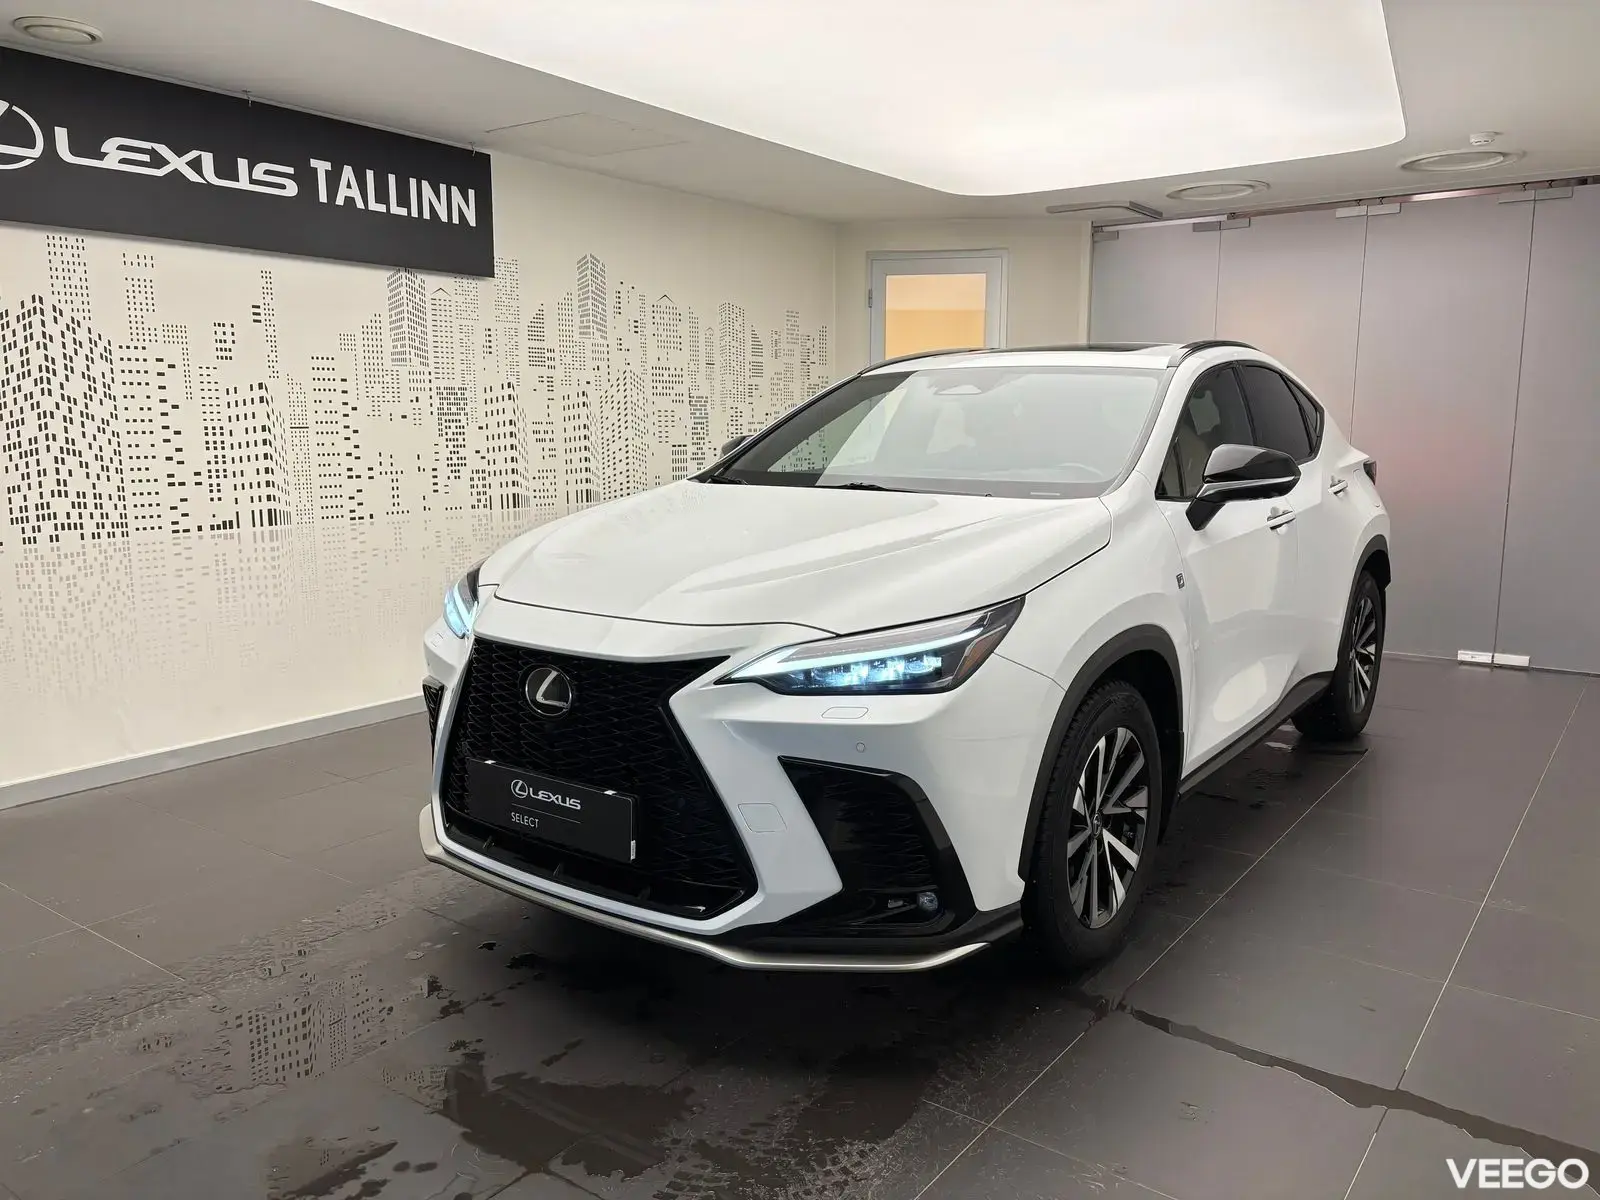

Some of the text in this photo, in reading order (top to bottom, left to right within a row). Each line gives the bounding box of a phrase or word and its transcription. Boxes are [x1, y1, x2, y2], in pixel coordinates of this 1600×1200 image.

[54, 126, 476, 227] LEXUS TALLINN
[529, 787, 581, 810] LEXUS
[511, 812, 539, 828] SELECT
